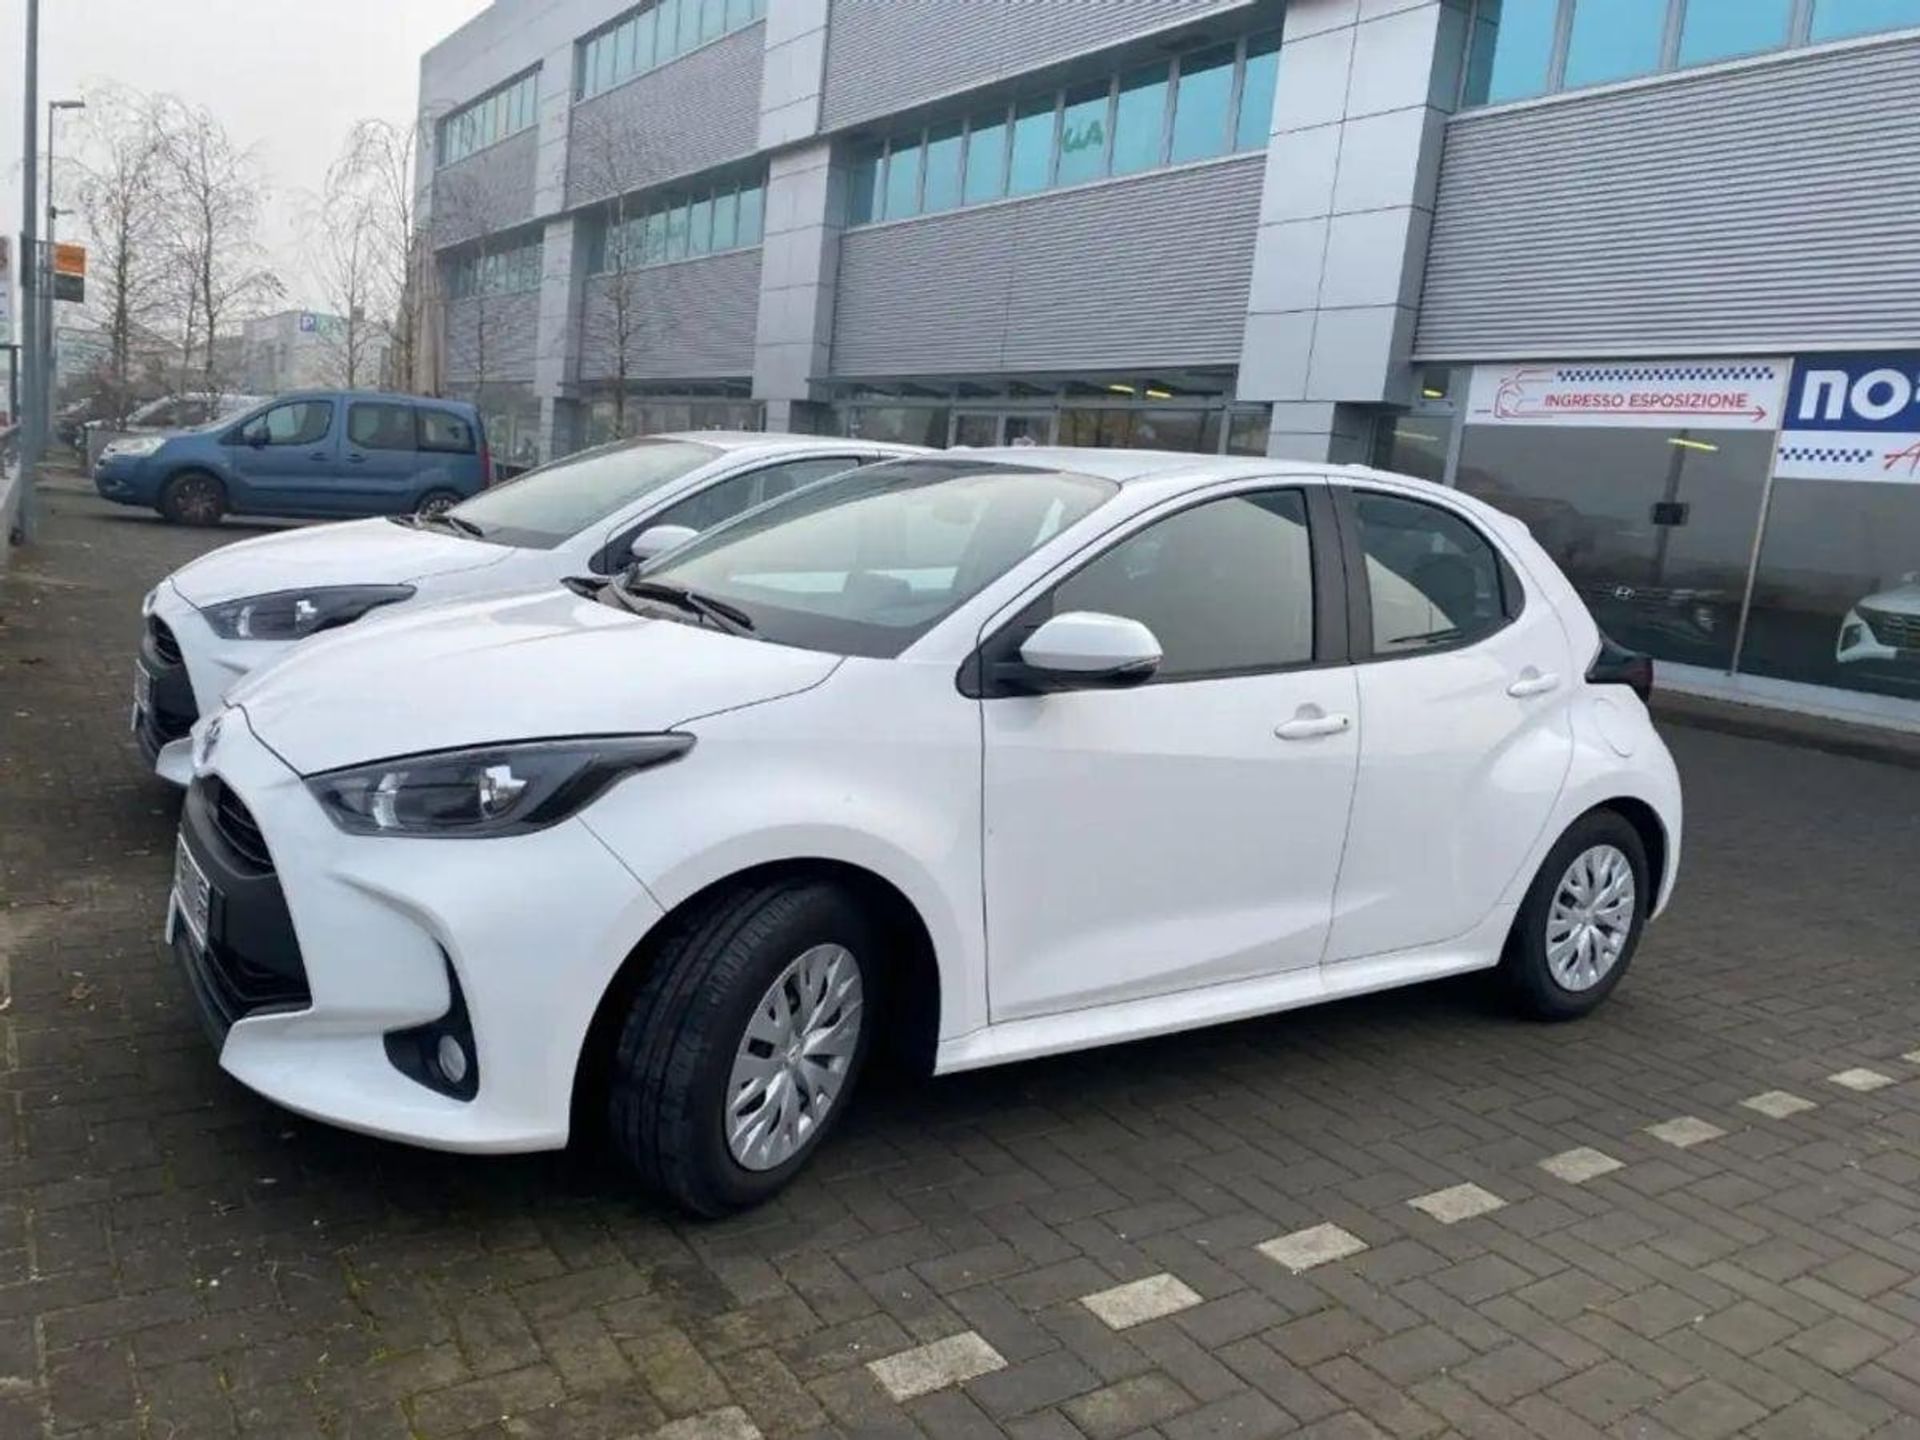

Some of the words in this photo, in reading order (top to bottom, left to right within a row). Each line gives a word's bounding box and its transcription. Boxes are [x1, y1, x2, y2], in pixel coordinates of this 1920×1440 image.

[1545, 393, 1624, 407] INGRESSO
[1628, 393, 1748, 408] ESPOSIZIONE
[1798, 368, 1920, 420] no
